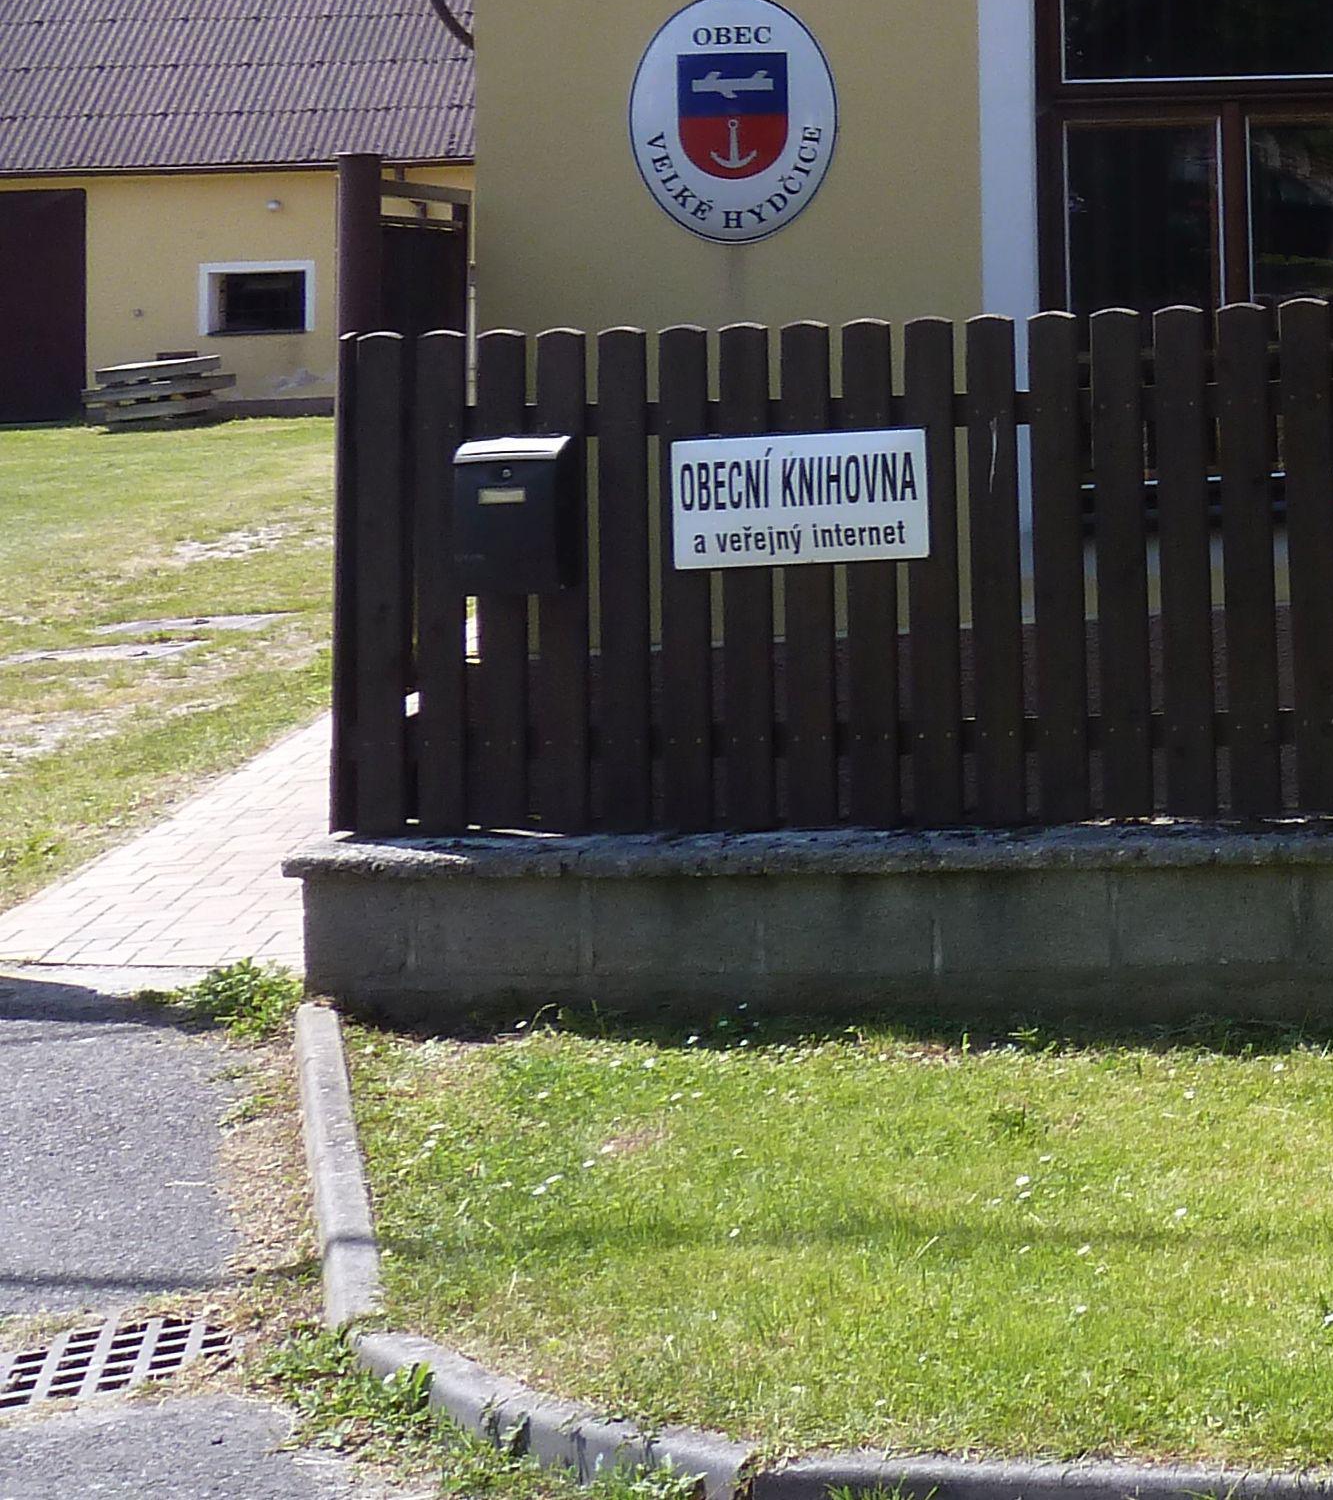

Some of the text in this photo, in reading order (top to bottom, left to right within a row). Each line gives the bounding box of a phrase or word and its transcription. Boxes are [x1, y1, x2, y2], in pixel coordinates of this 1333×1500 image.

[692, 26, 772, 46] OBEC
[645, 125, 822, 230] VELKÉ HYDČICE
[680, 447, 918, 511] OBECNÍ KNIHOVNA
[694, 520, 906, 555] a veřejný internet
